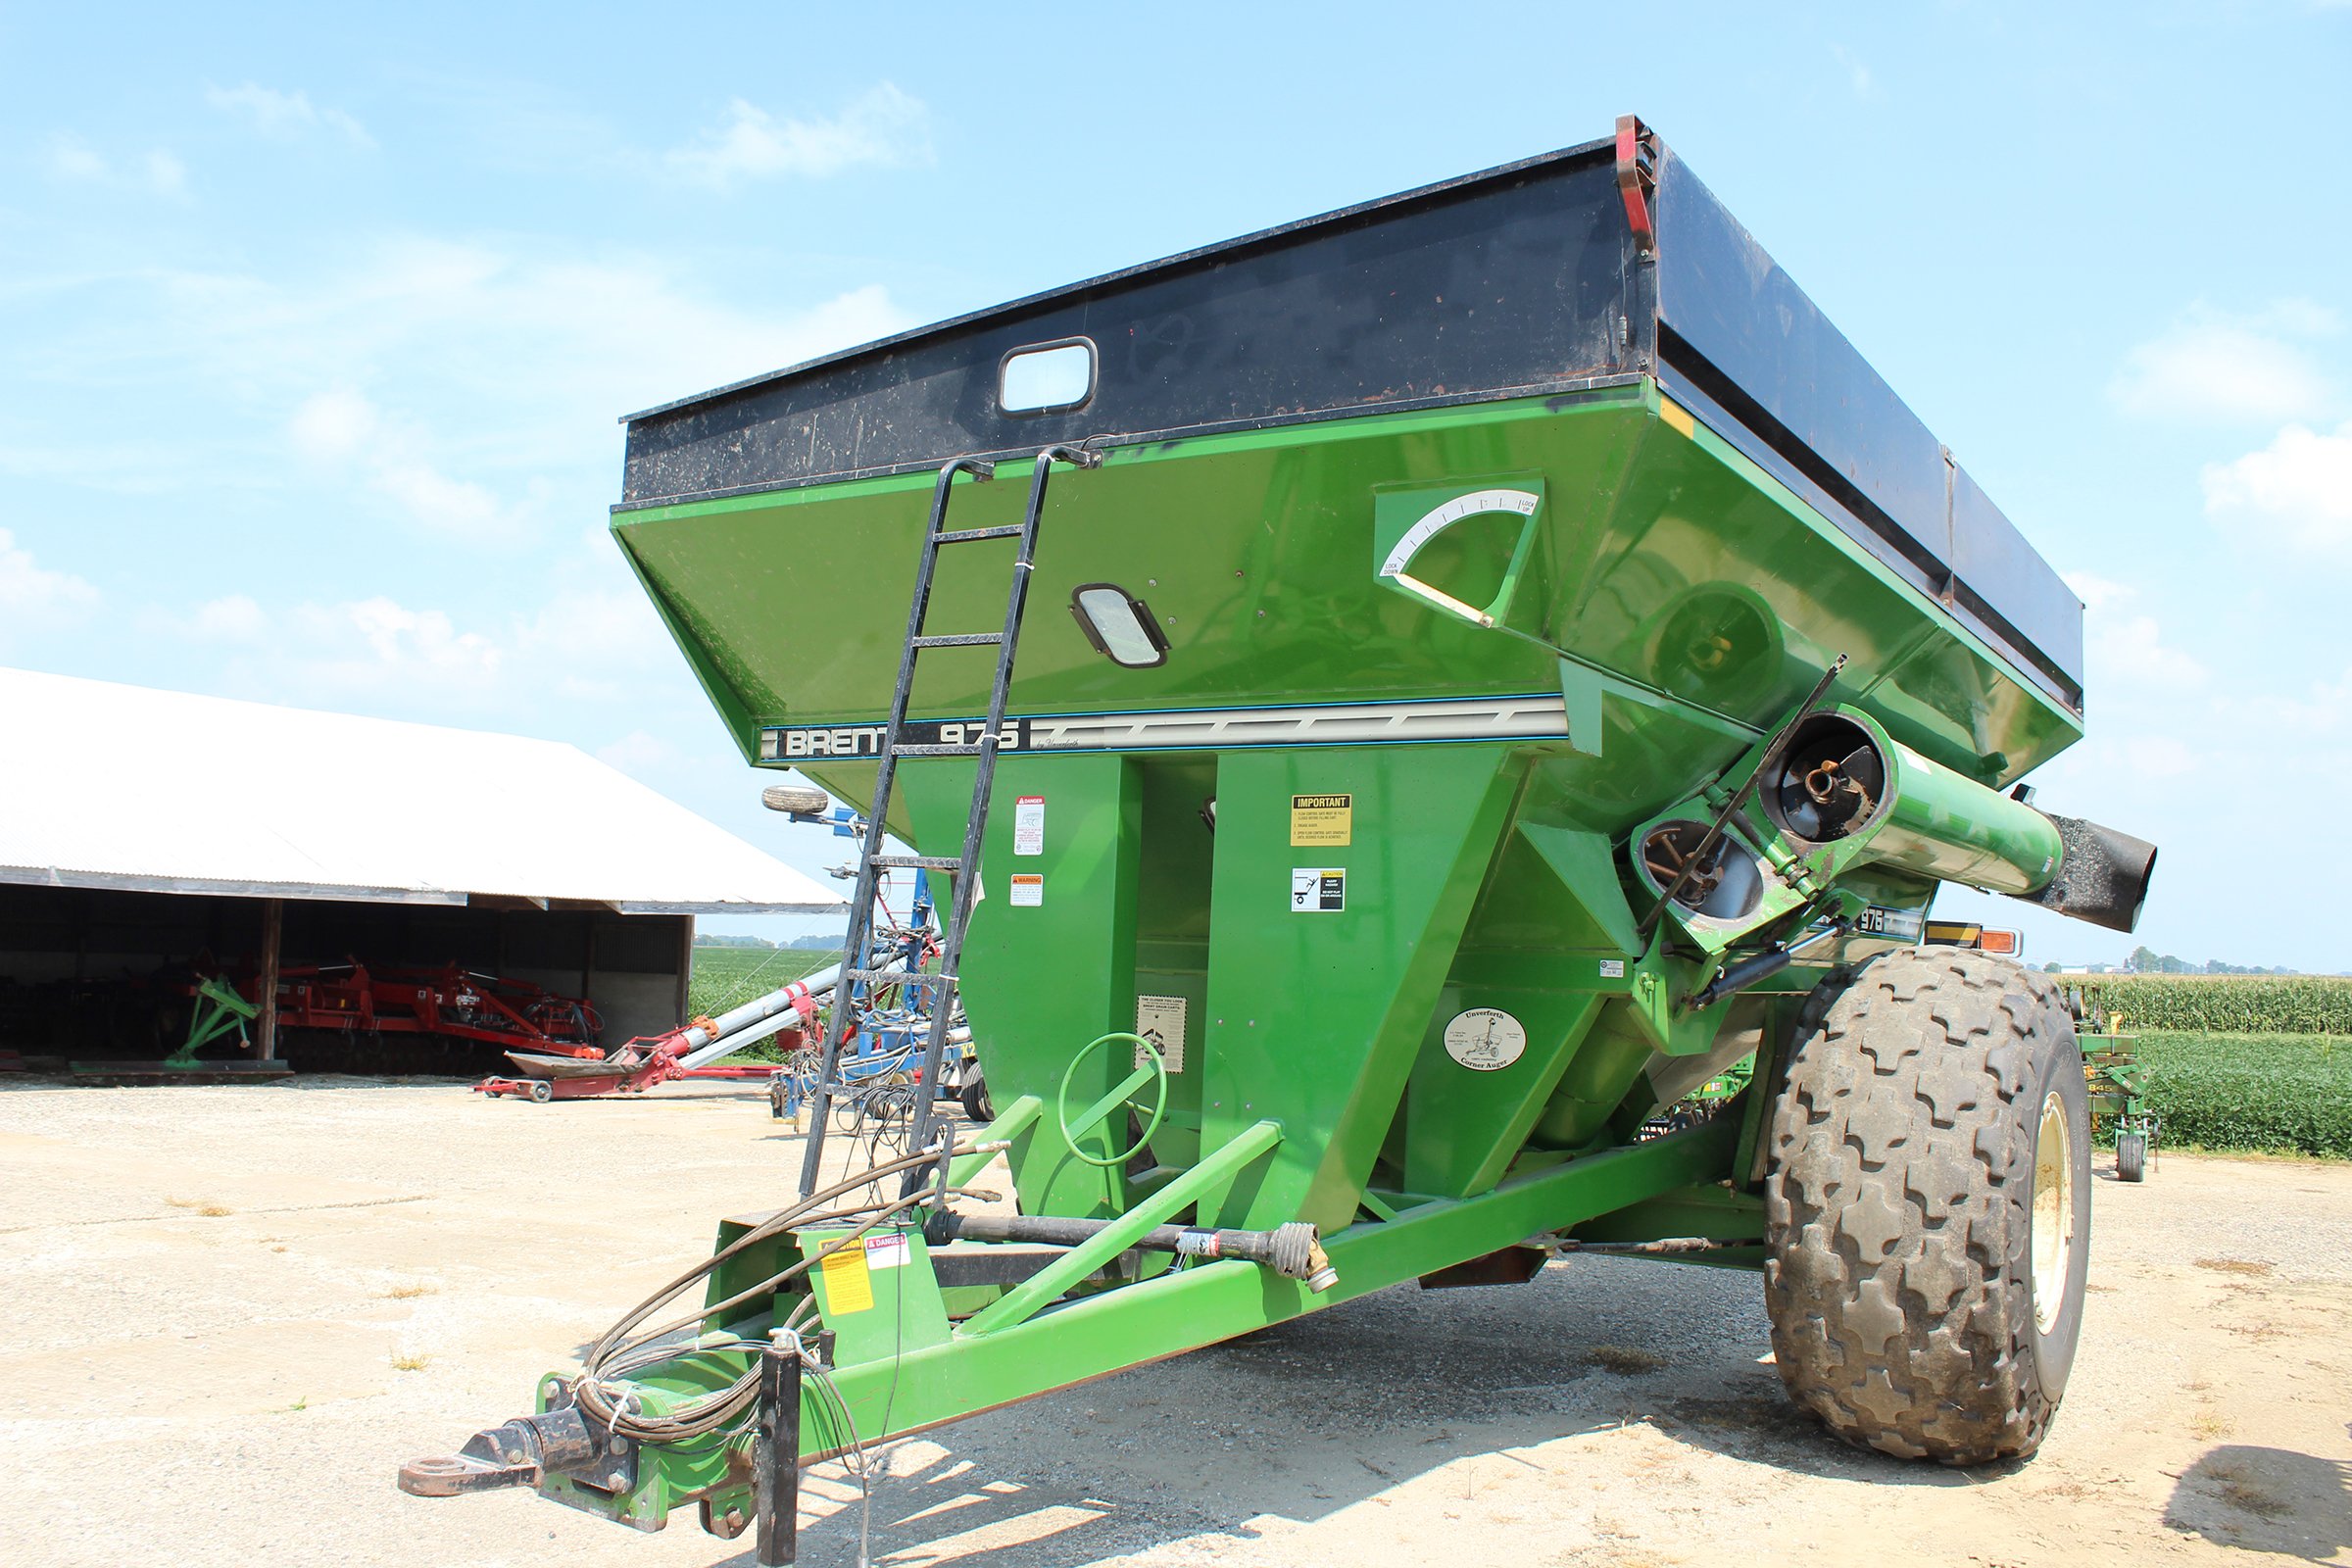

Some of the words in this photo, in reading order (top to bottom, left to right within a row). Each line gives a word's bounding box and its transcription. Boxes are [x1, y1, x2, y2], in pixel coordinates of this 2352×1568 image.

[1298, 797, 1347, 808] IMPORTANT
[1861, 907, 1883, 931] 976
[1465, 1009, 1504, 1020] Unverferth
[1460, 1057, 1485, 1068] Corner
[1486, 1059, 1507, 1068] Auger
[875, 1236, 905, 1248] DANGER
